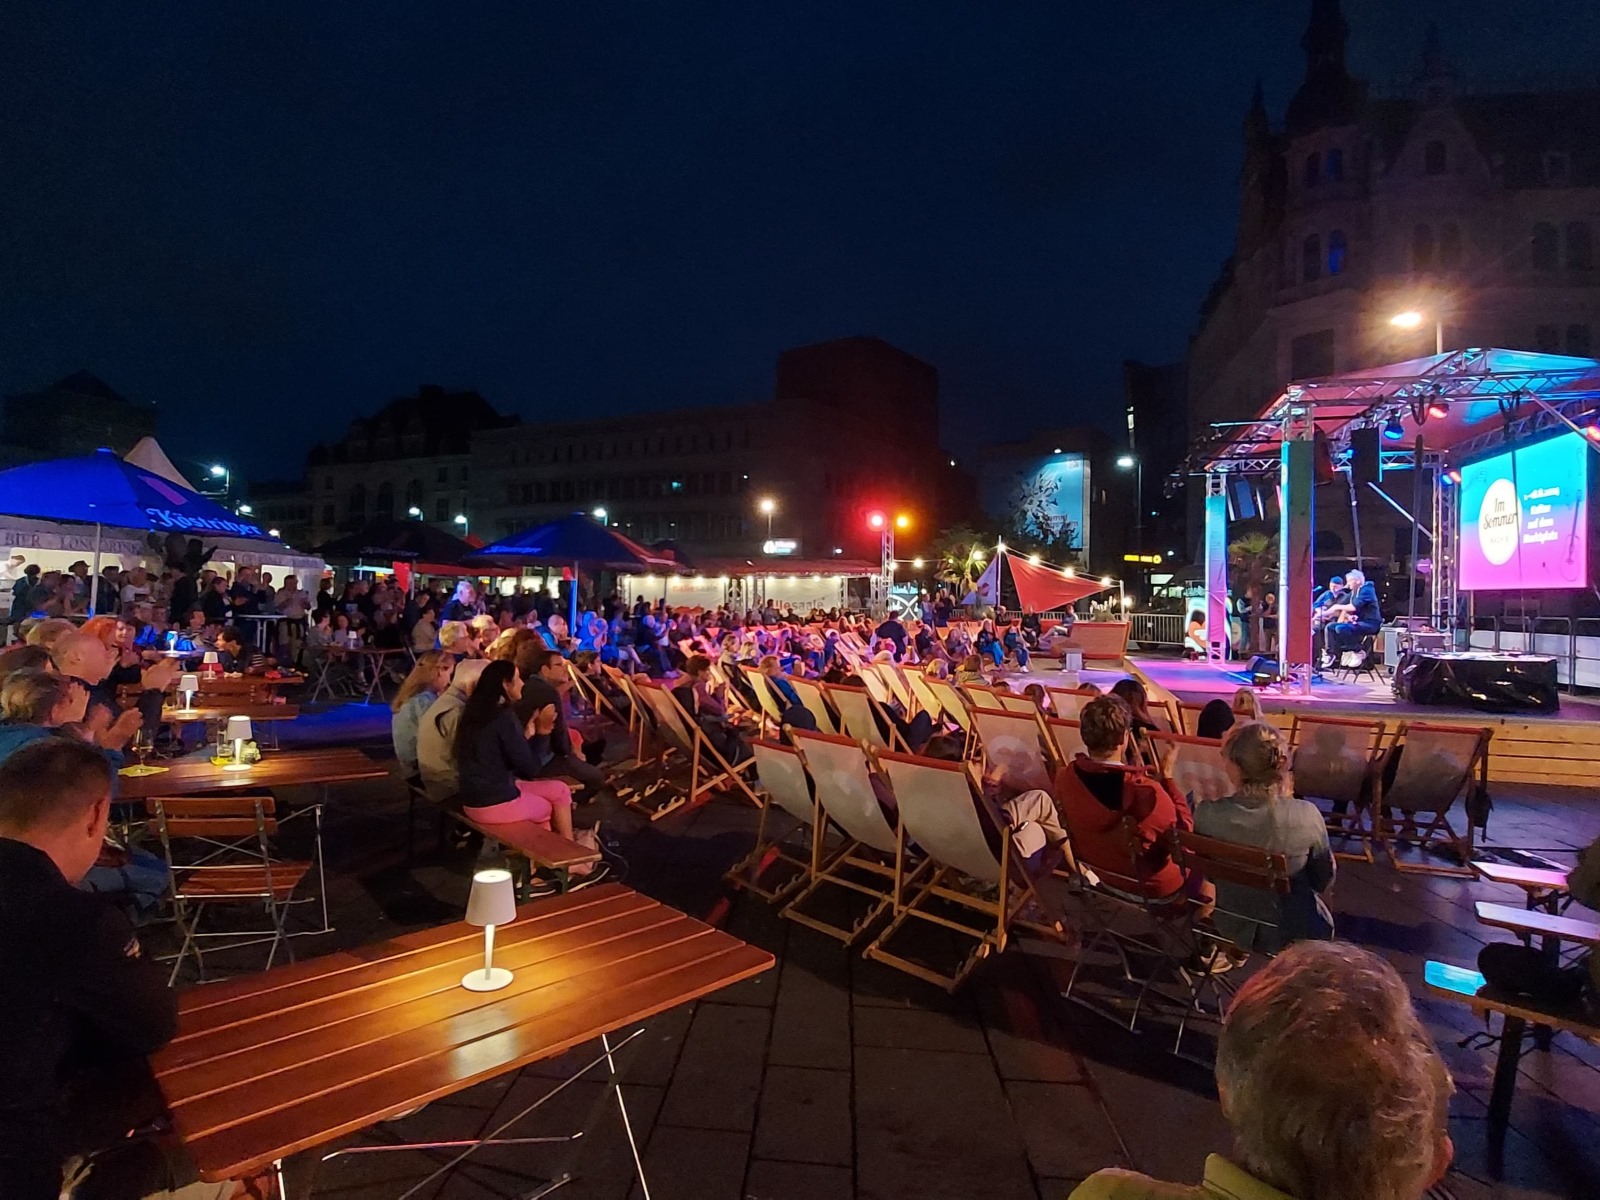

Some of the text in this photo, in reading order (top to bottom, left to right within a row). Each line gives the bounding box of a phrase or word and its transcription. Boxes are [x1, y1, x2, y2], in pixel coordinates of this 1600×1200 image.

[1494, 497, 1505, 513] Im
[146, 507, 263, 535] Köstritzer
[1483, 512, 1517, 530] Sommer
[4, 532, 41, 546] BIER
